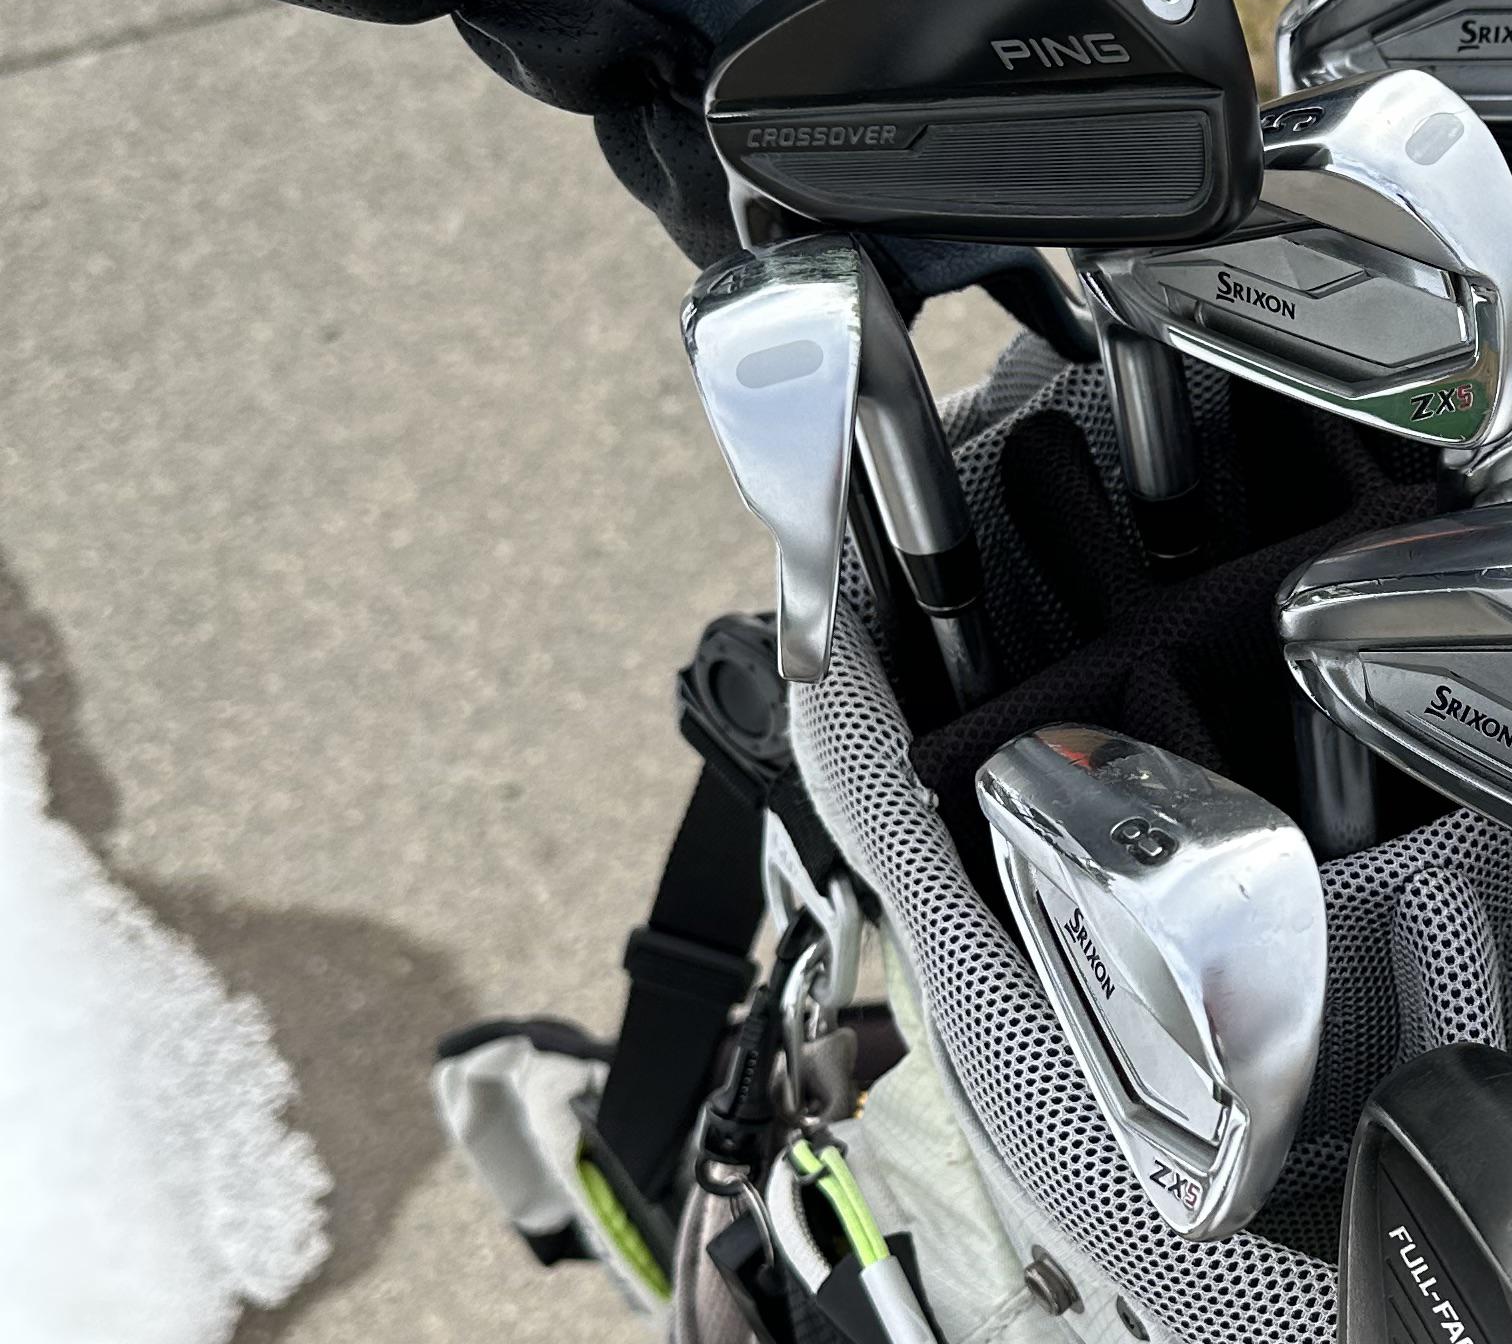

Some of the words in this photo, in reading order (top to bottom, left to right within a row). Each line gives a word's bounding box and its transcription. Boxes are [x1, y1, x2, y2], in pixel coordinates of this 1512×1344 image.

[991, 32, 1131, 71] PING
[746, 124, 898, 150] CROSSOVER
[1215, 271, 1297, 321] SRIXON
[1409, 383, 1474, 423] ZX5
[1109, 815, 1181, 865] 8
[1064, 906, 1116, 1001] SRIXON
[1148, 1158, 1205, 1211] ZX5
